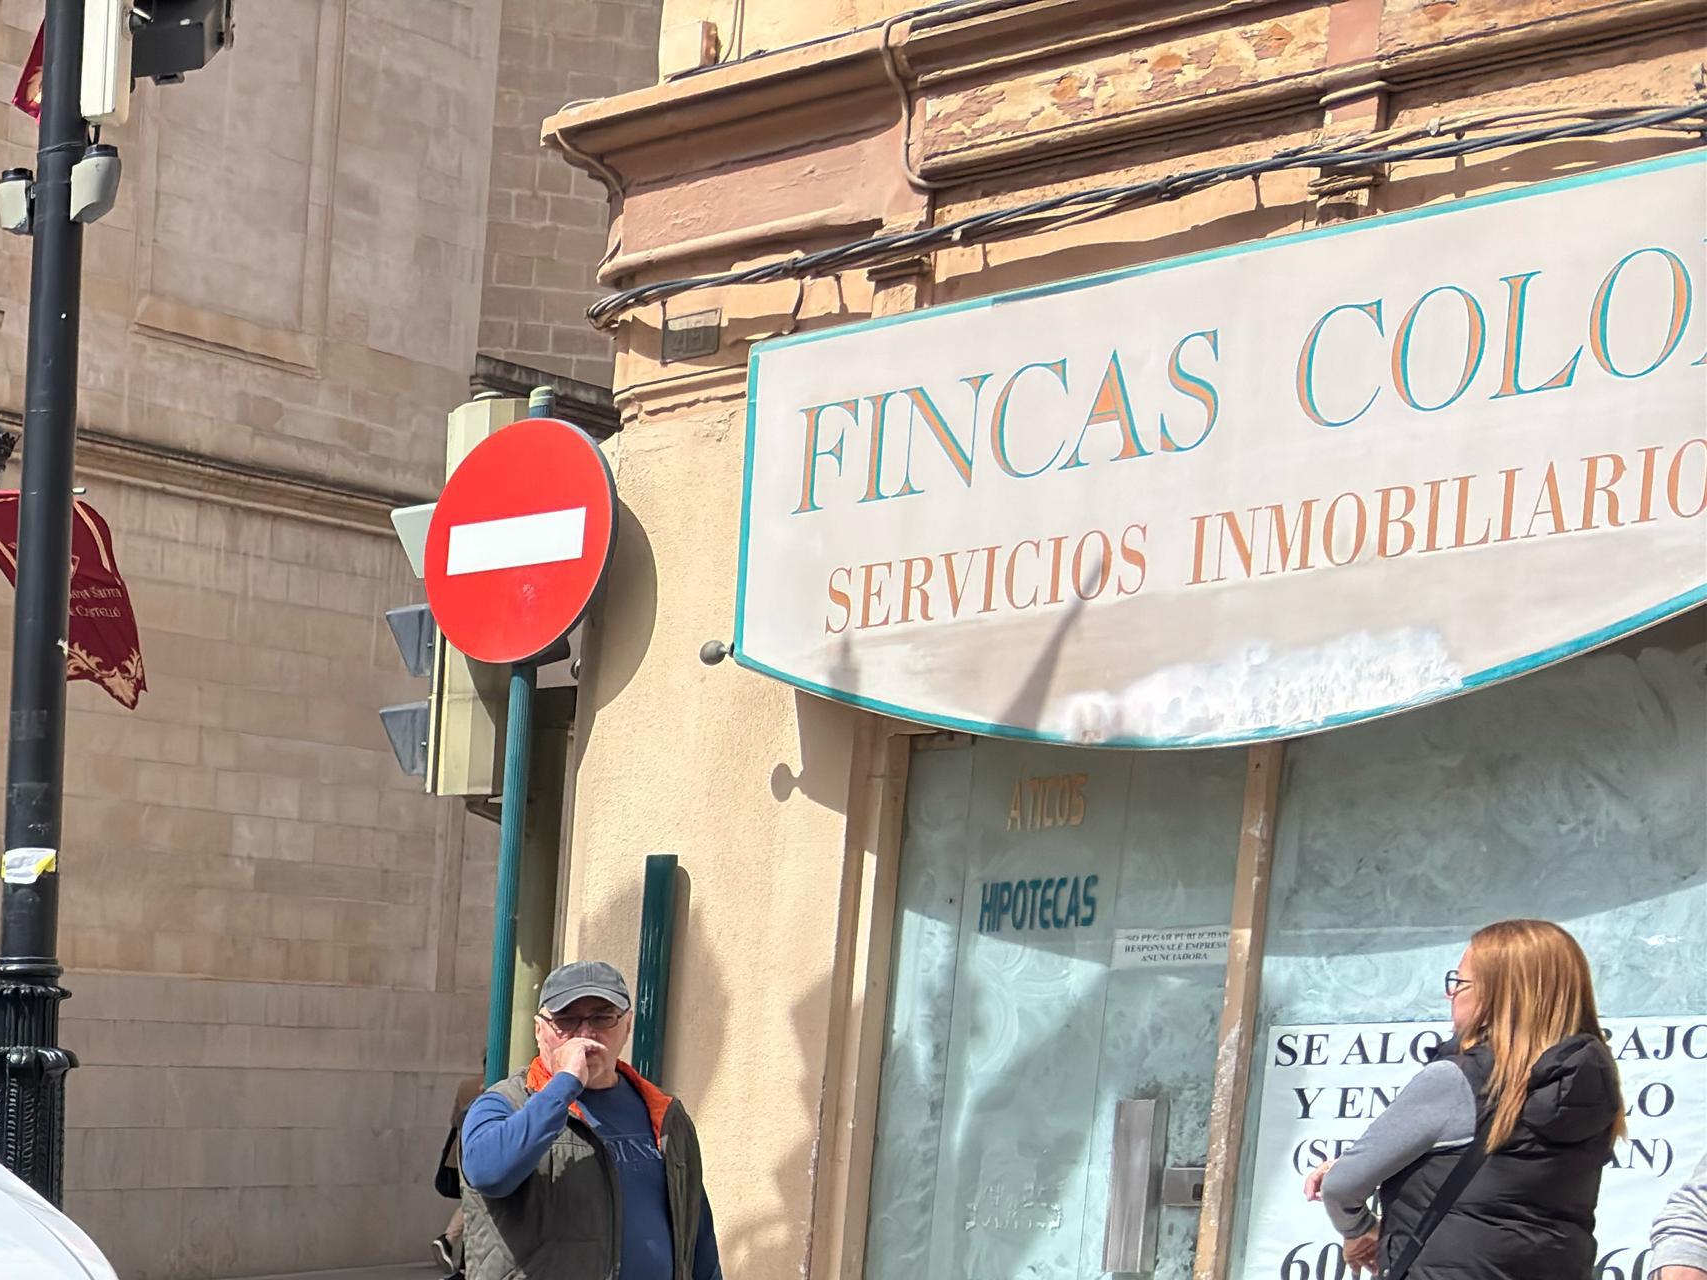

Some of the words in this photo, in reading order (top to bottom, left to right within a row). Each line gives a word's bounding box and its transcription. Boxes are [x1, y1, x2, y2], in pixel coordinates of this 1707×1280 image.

[791, 328, 1220, 515] FINCAS
[1295, 235, 1707, 429] COLO
[824, 523, 1149, 635] SERVICIOS
[978, 874, 1099, 933] HIPOTECAS
[1140, 932, 1172, 942] PEGAR
[1185, 941, 1228, 950] EMPRESA
[1140, 952, 1209, 962] ANUNCIADORA
[1274, 1031, 1330, 1067] SE
[1293, 1086, 1325, 1120] Y
